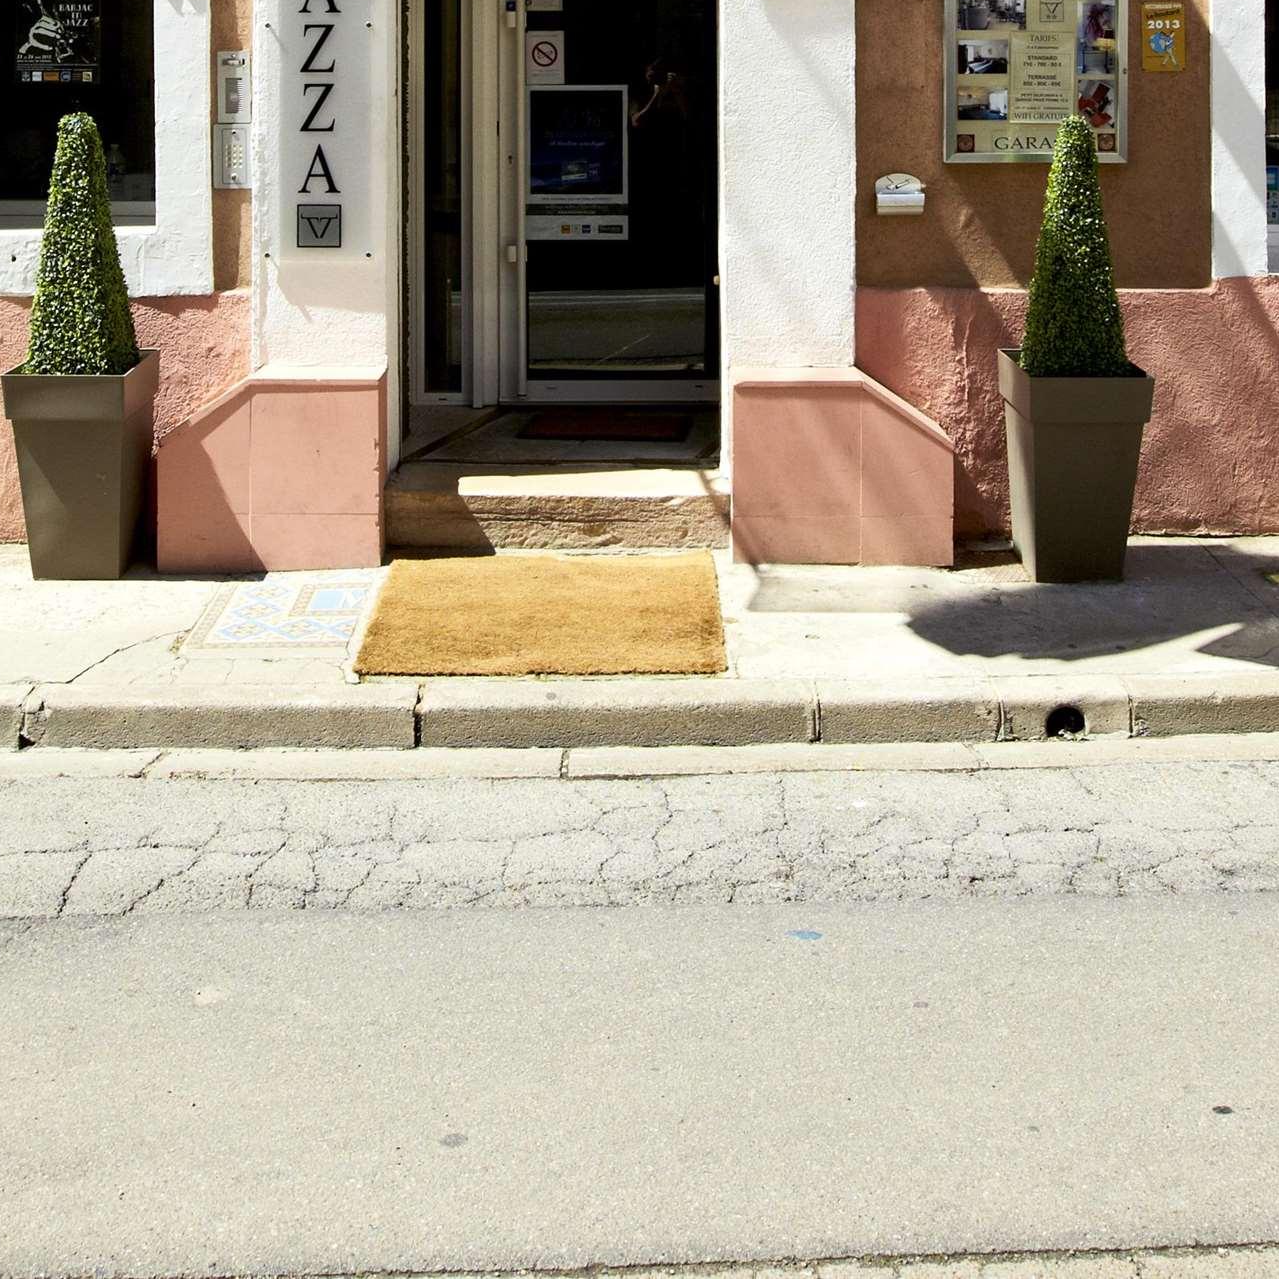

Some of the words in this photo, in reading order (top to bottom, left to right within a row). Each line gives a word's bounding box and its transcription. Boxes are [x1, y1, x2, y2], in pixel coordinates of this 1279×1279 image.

[65, 19, 89, 27] JAZZ
[1147, 20, 1180, 29] 2013
[994, 136, 1057, 150] GARA
